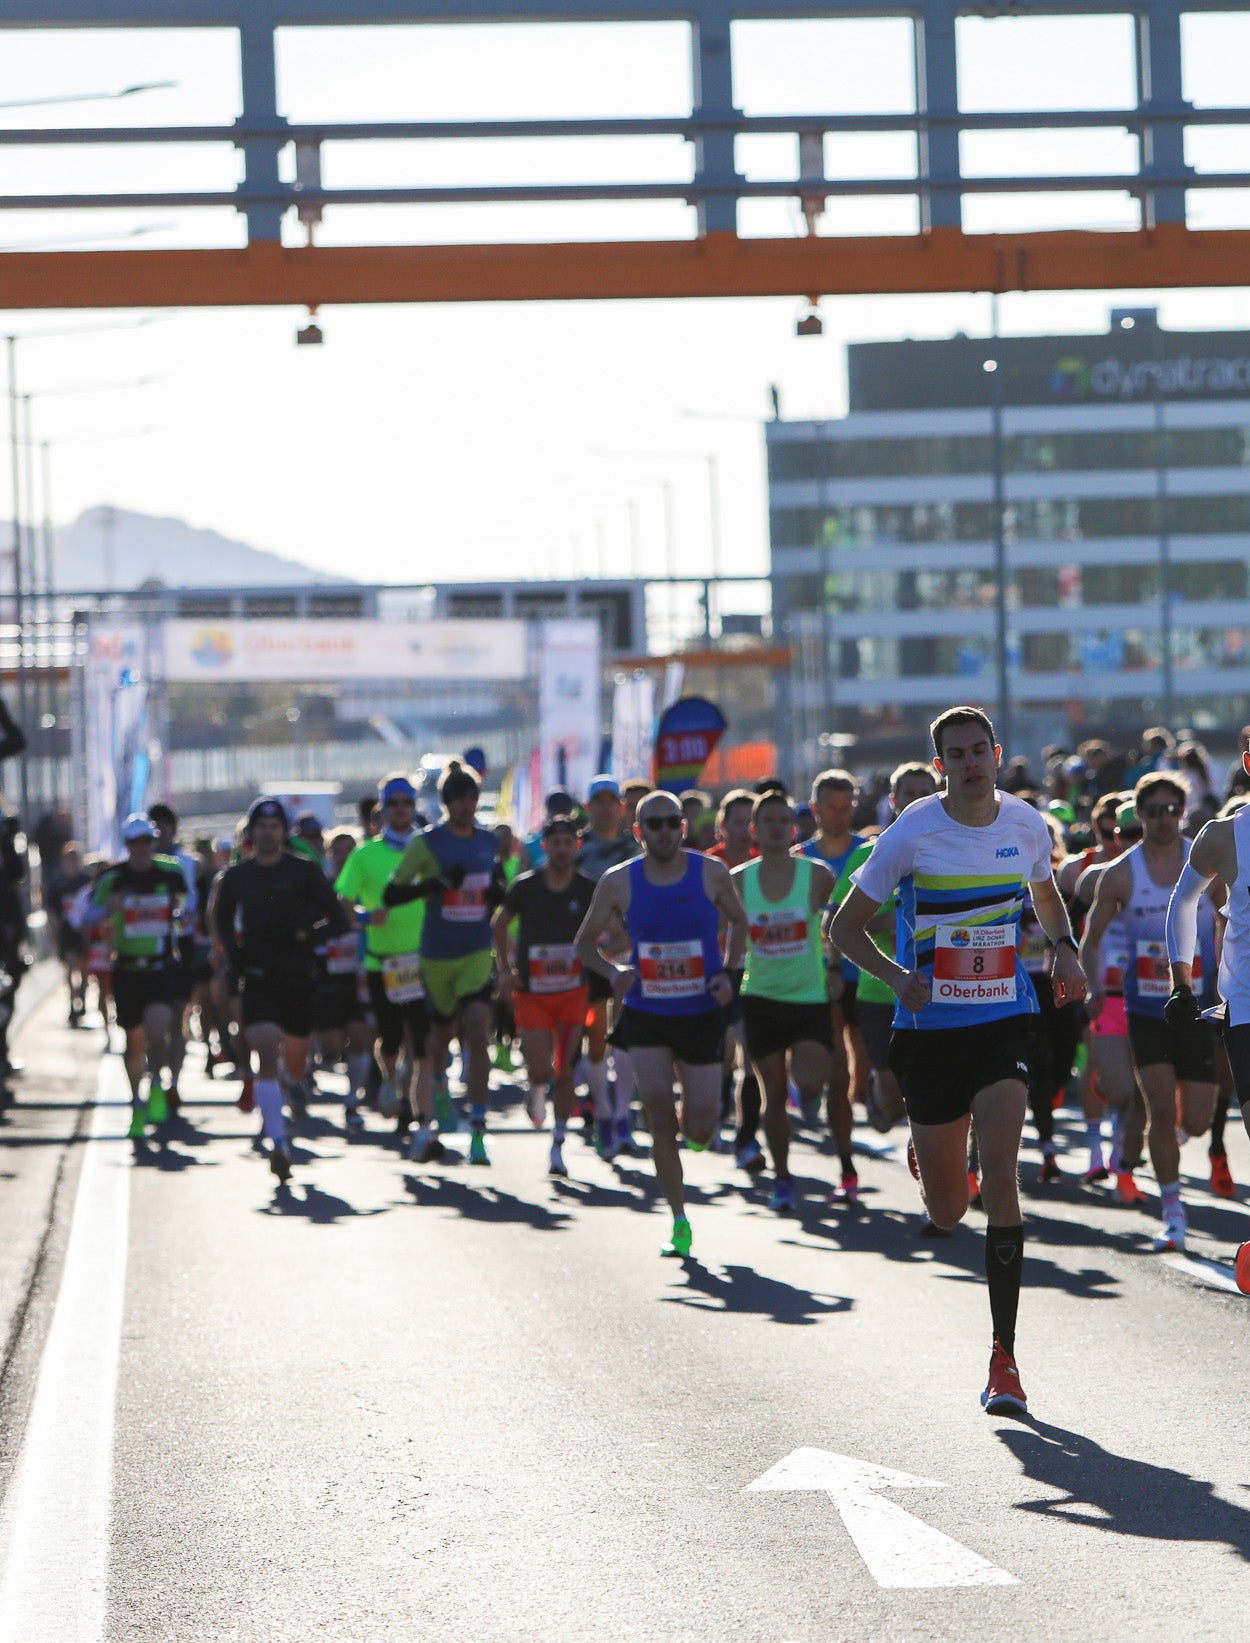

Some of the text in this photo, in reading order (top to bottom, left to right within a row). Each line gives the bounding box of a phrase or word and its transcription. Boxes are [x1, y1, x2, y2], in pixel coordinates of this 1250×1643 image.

[995, 846, 1020, 859] HOKA
[658, 964, 685, 978] 214
[973, 956, 984, 973] 8
[940, 983, 1008, 997] Oberbank
